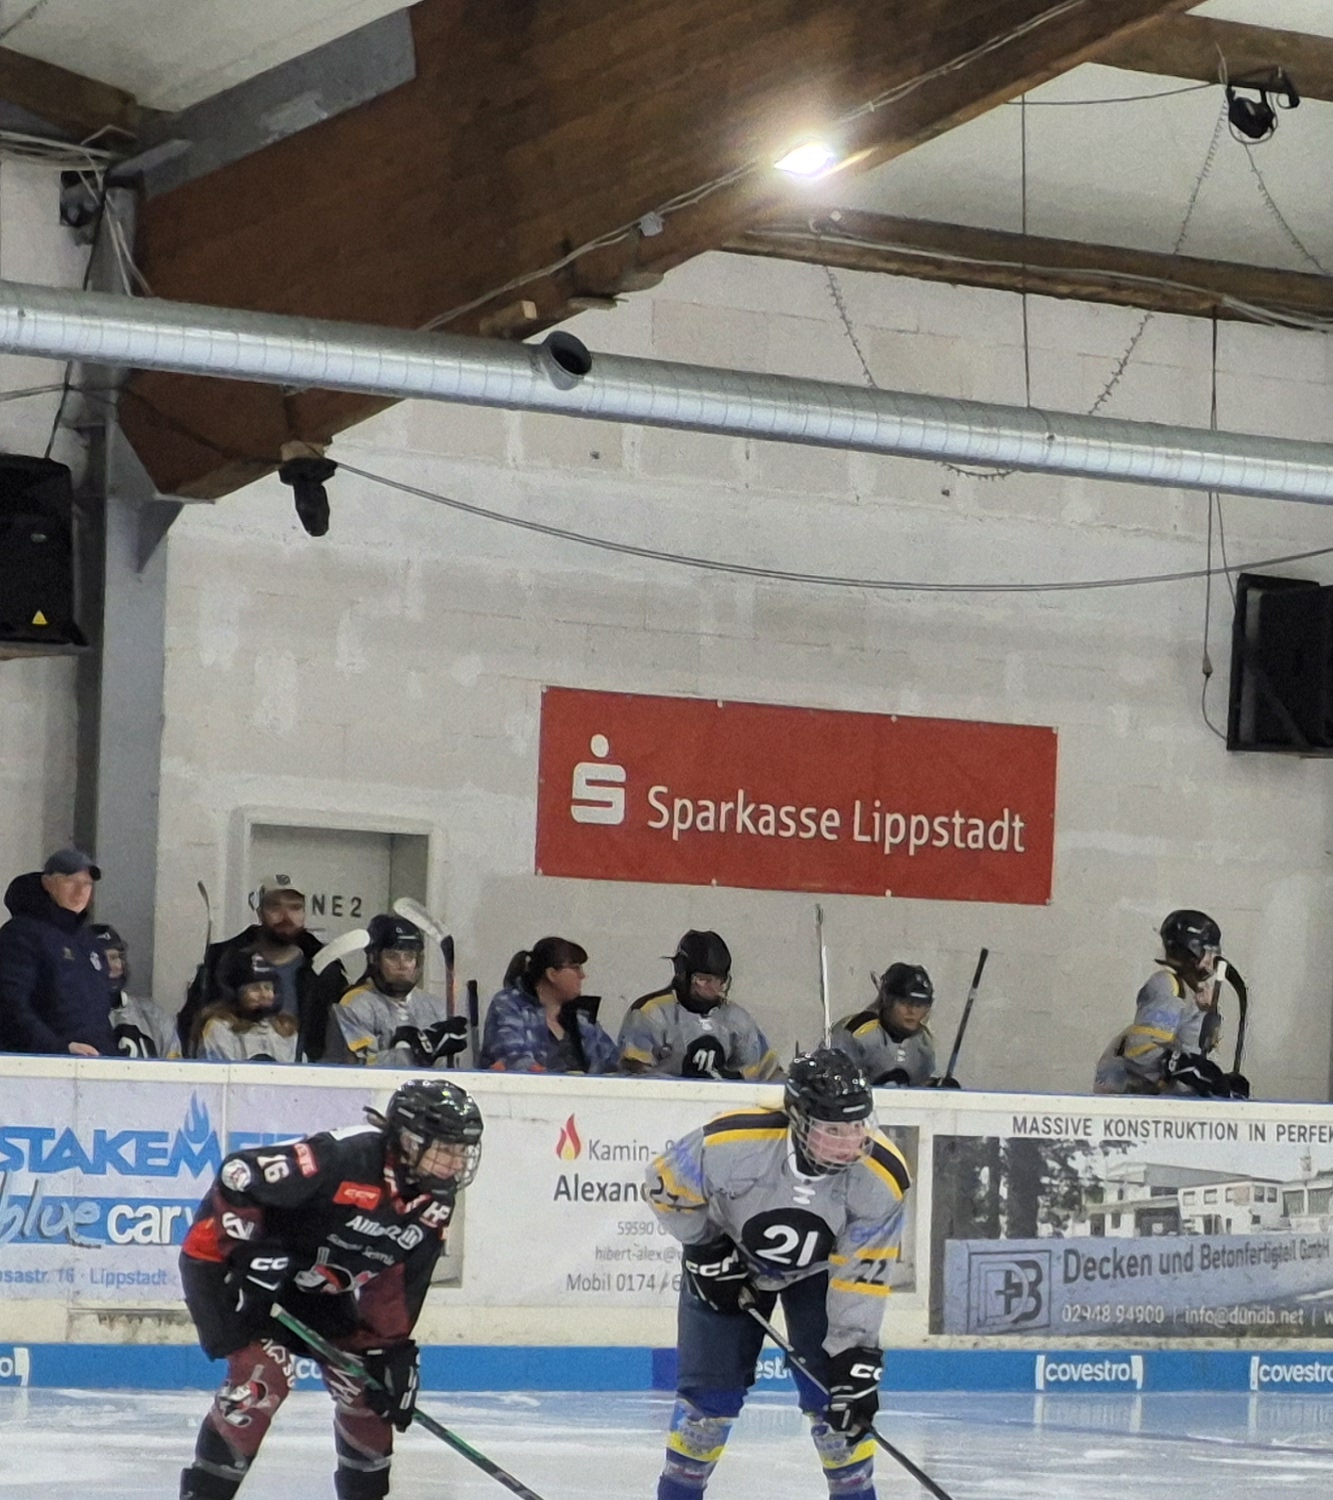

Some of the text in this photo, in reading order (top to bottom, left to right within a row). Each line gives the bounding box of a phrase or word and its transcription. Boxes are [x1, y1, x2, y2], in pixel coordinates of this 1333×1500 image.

[647, 785, 1025, 856] Sparkasse Lippstadt
[1012, 1115, 1093, 1137] MASSIVE
[1103, 1118, 1239, 1142] KONSTRUKTION
[1248, 1122, 1267, 1143] IN
[755, 1223, 819, 1267] 21
[89, 1268, 168, 1288] Lippstadt
[1062, 1246, 1152, 1284] Decken
[1158, 1246, 1194, 1275] und
[565, 1273, 611, 1292] Mobil
[616, 1273, 656, 1292] 0174
[1045, 1359, 1132, 1382] covestro
